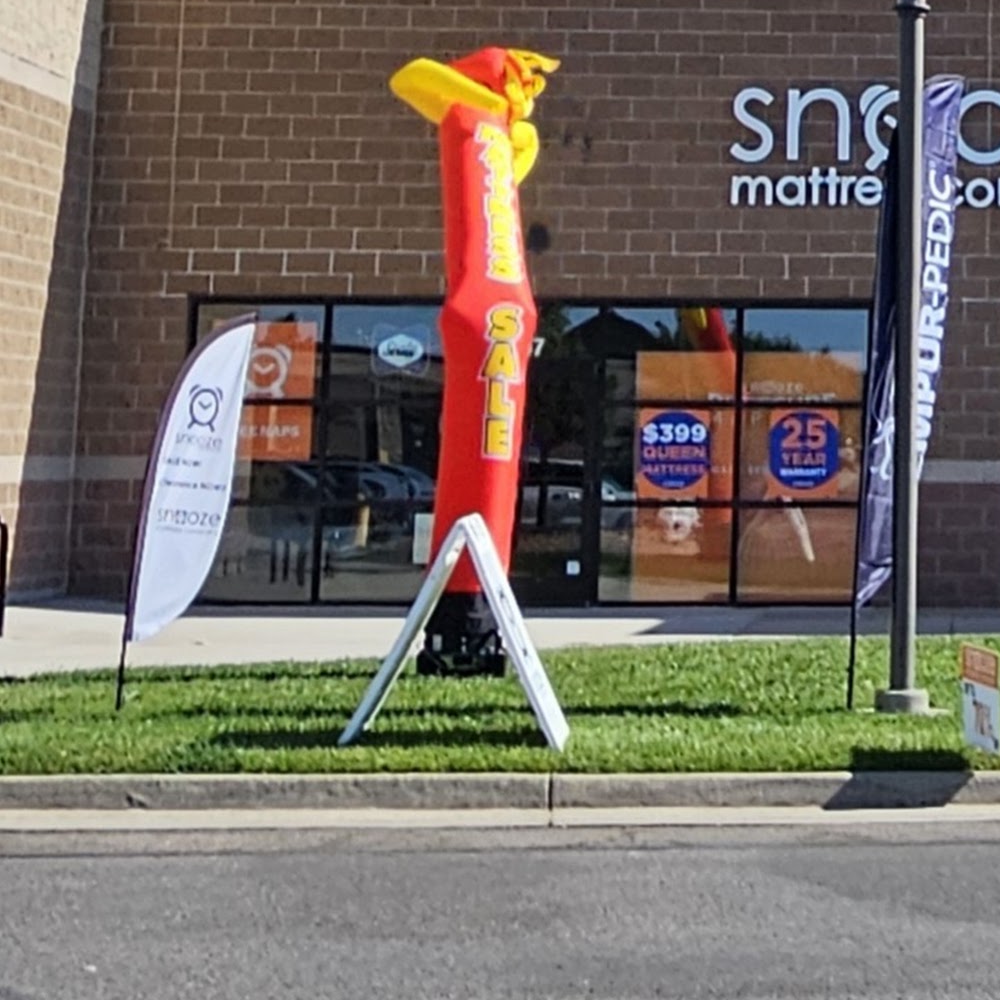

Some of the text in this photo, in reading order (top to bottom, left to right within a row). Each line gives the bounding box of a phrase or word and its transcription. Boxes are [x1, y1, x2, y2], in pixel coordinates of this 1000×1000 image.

[730, 166, 883, 206] mattre
[480, 303, 524, 460] SALE
[642, 422, 707, 445] $399
[781, 417, 827, 450] 25
[643, 445, 706, 460] QUEEN
[781, 452, 827, 466] YEAR
